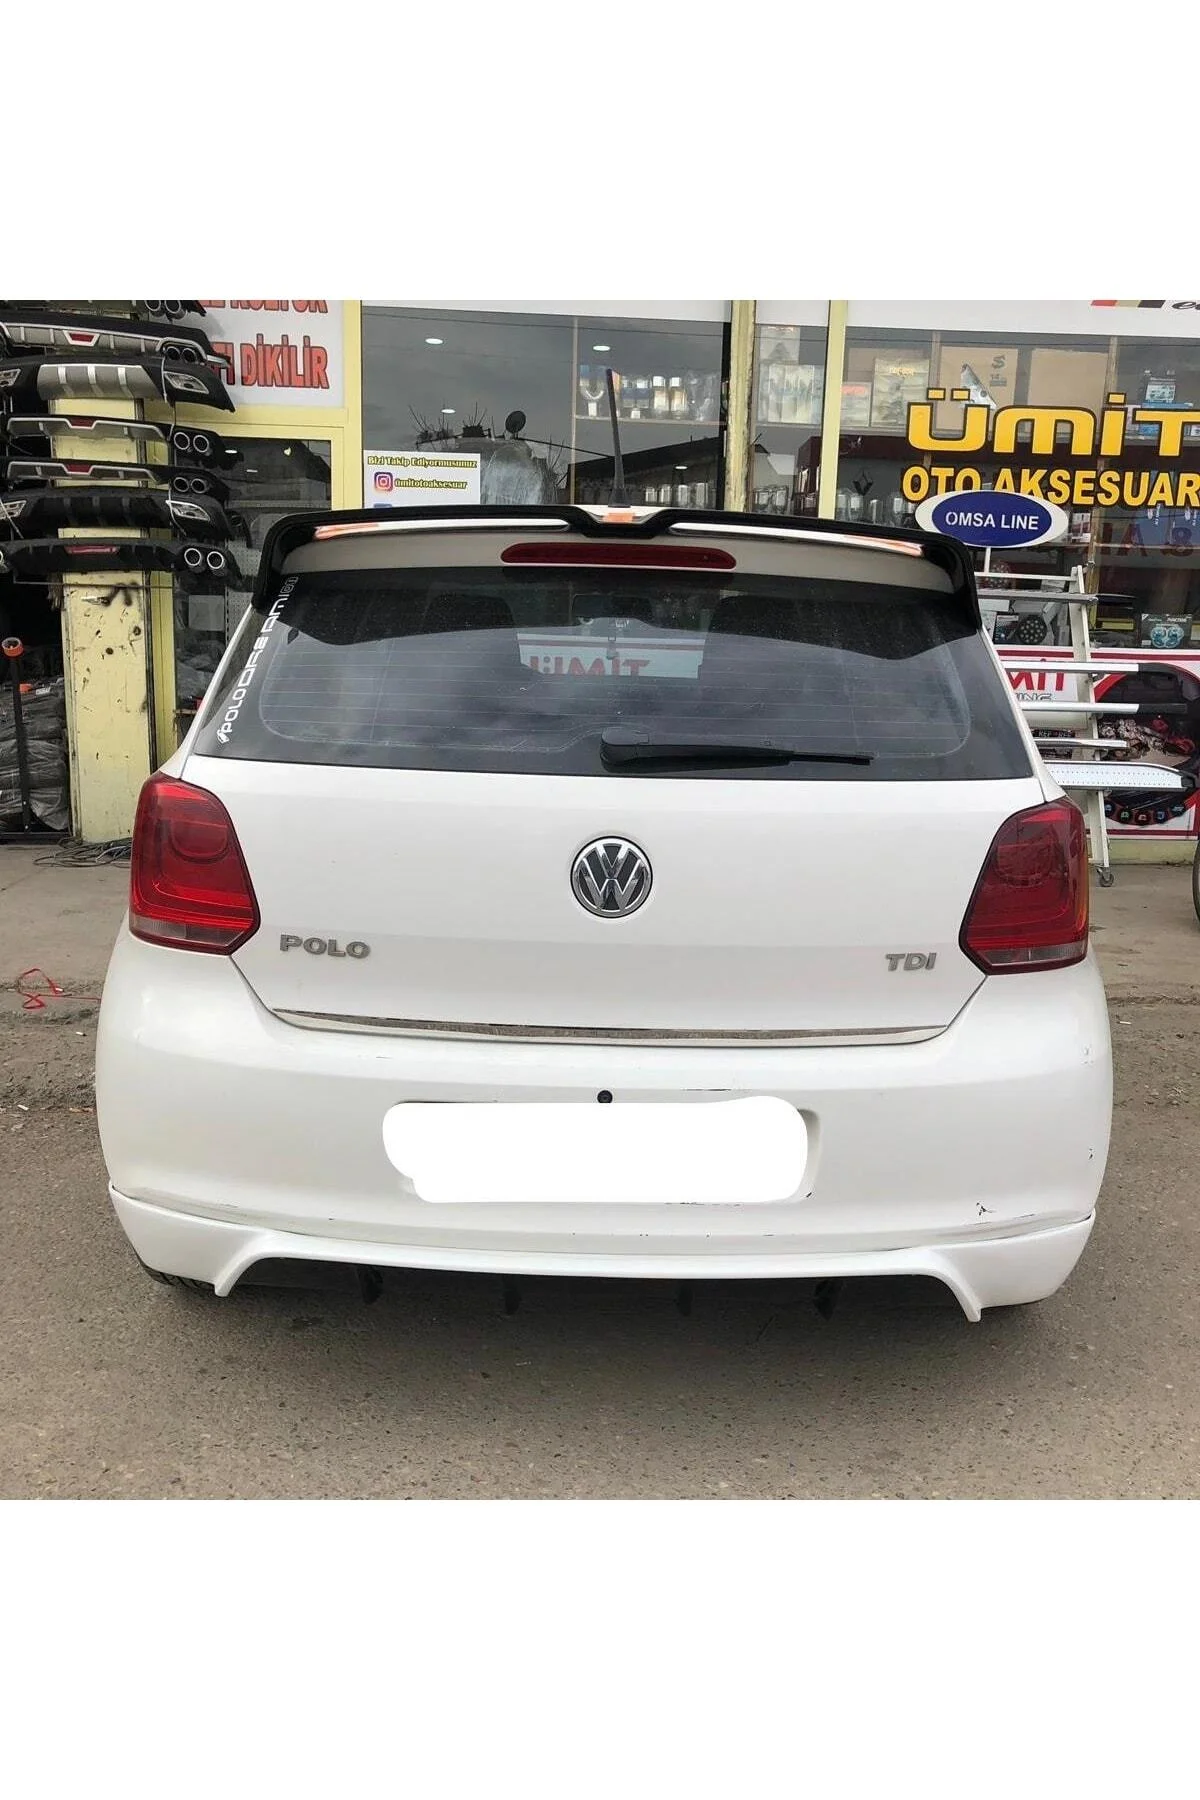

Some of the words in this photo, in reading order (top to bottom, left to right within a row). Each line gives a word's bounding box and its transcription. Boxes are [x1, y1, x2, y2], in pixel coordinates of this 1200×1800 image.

[240, 333, 330, 390] DİKİLİR
[367, 455, 385, 466] Bizi
[385, 456, 411, 468] Takip
[902, 464, 984, 503] OTO
[993, 466, 1200, 508] AKSESUAR
[945, 511, 996, 528] OMSA
[1001, 514, 1040, 530] LINE
[280, 933, 371, 960] POLO
[884, 951, 937, 972] TDI
